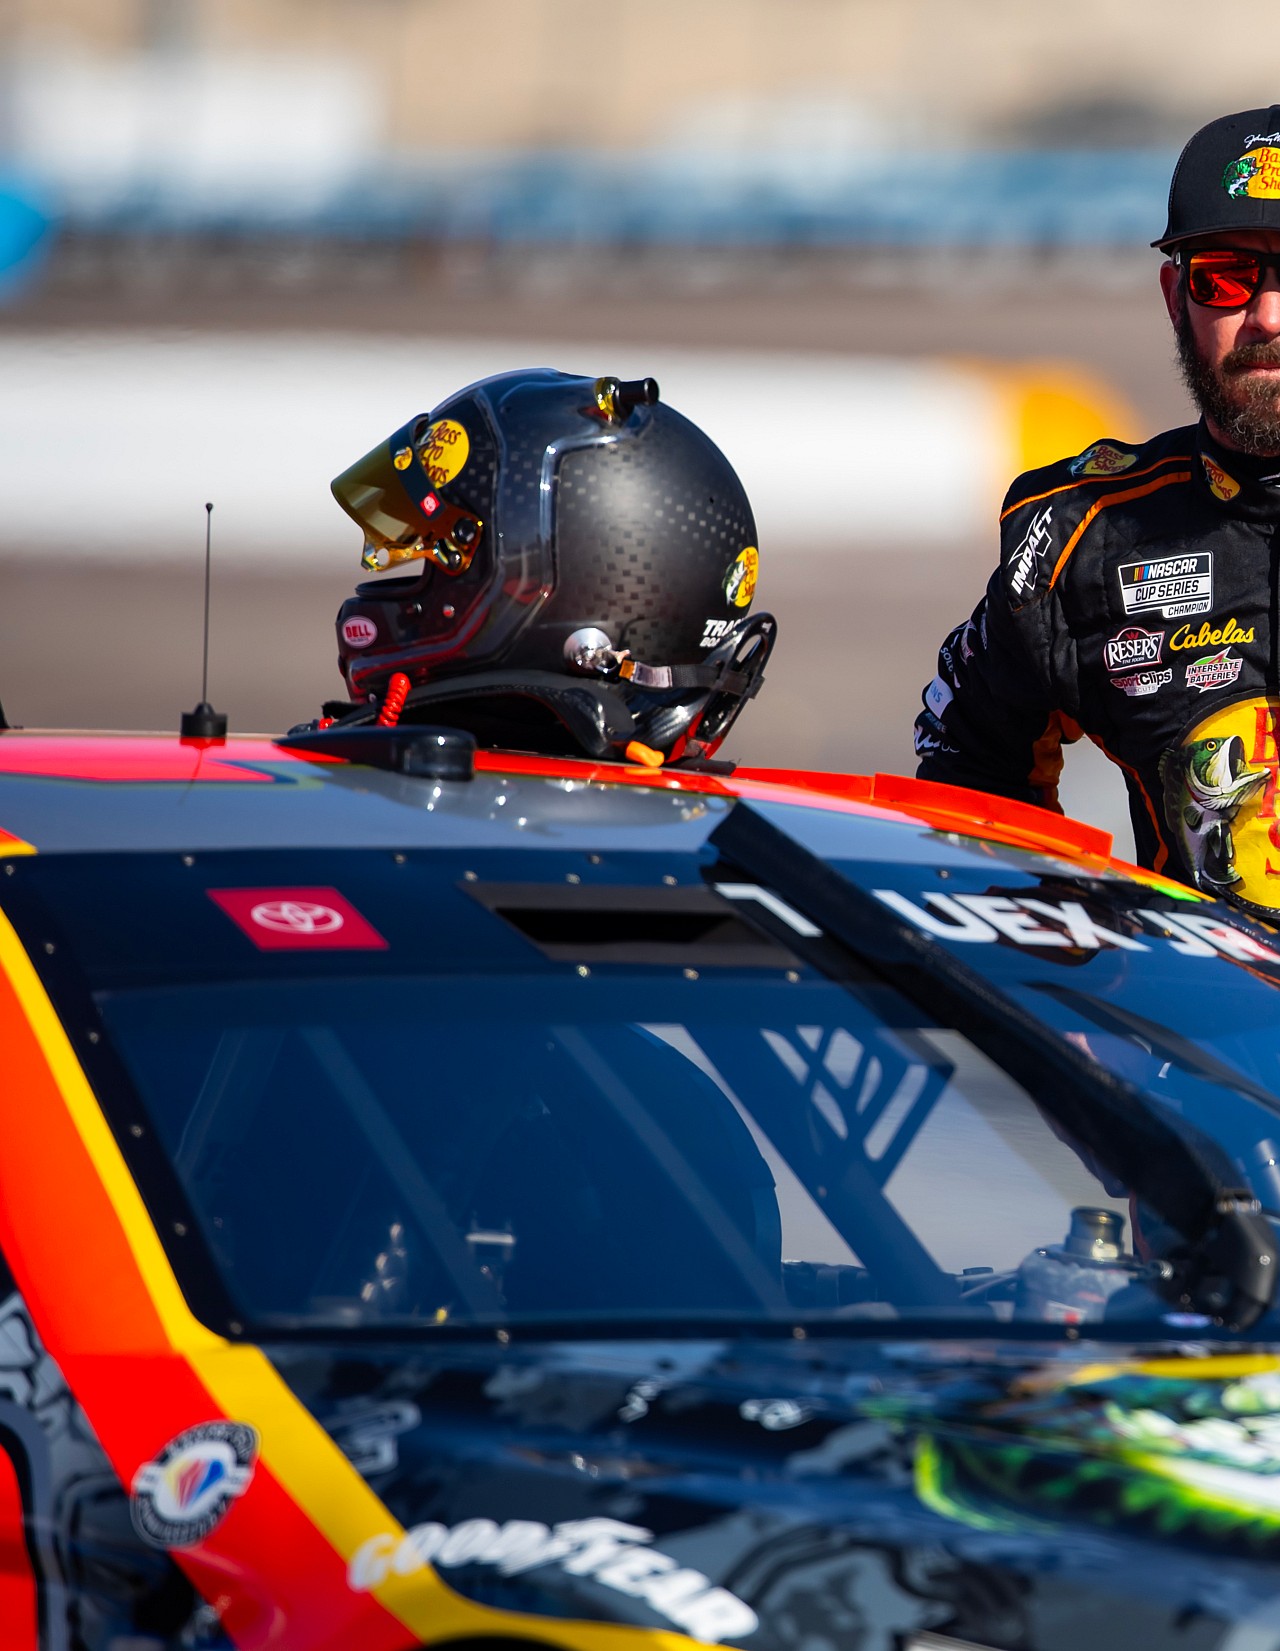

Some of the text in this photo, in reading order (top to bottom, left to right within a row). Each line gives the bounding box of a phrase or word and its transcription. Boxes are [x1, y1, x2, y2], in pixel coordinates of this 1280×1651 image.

[1010, 505, 1053, 595] IMPACT
[1147, 558, 1198, 580] NASCAR
[1135, 579, 1200, 602] CUP SERIES
[1167, 601, 1209, 616] CHAMPION
[345, 624, 373, 638] BELL
[1188, 661, 1240, 675] INTERSTATE
[1190, 670, 1237, 684] BATTERIES
[713, 882, 1152, 953] TUEX
